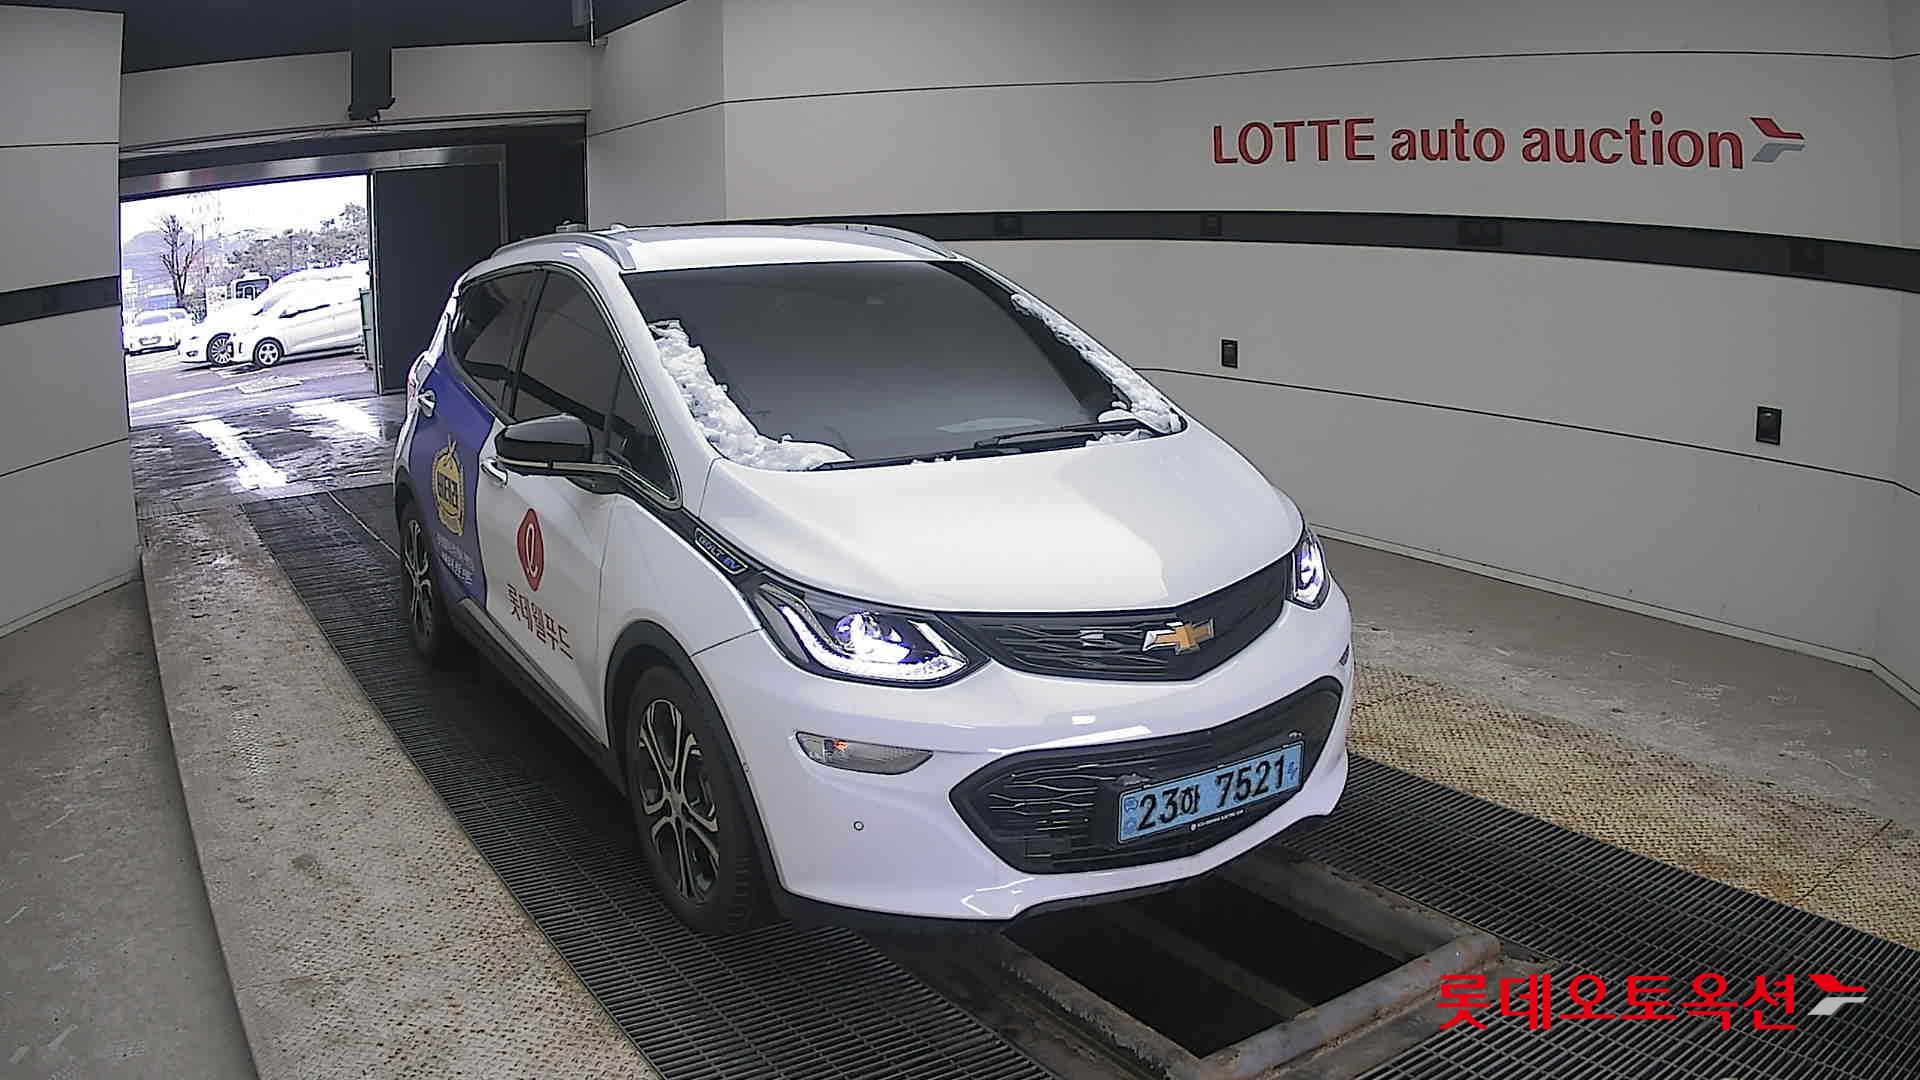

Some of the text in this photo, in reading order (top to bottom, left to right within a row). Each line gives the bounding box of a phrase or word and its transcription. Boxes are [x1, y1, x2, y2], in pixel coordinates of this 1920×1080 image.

[1212, 111, 1743, 169] LOTTE auto auction
[507, 583, 574, 660] 롯데웰푸드
[1214, 755, 1286, 809] 7521
